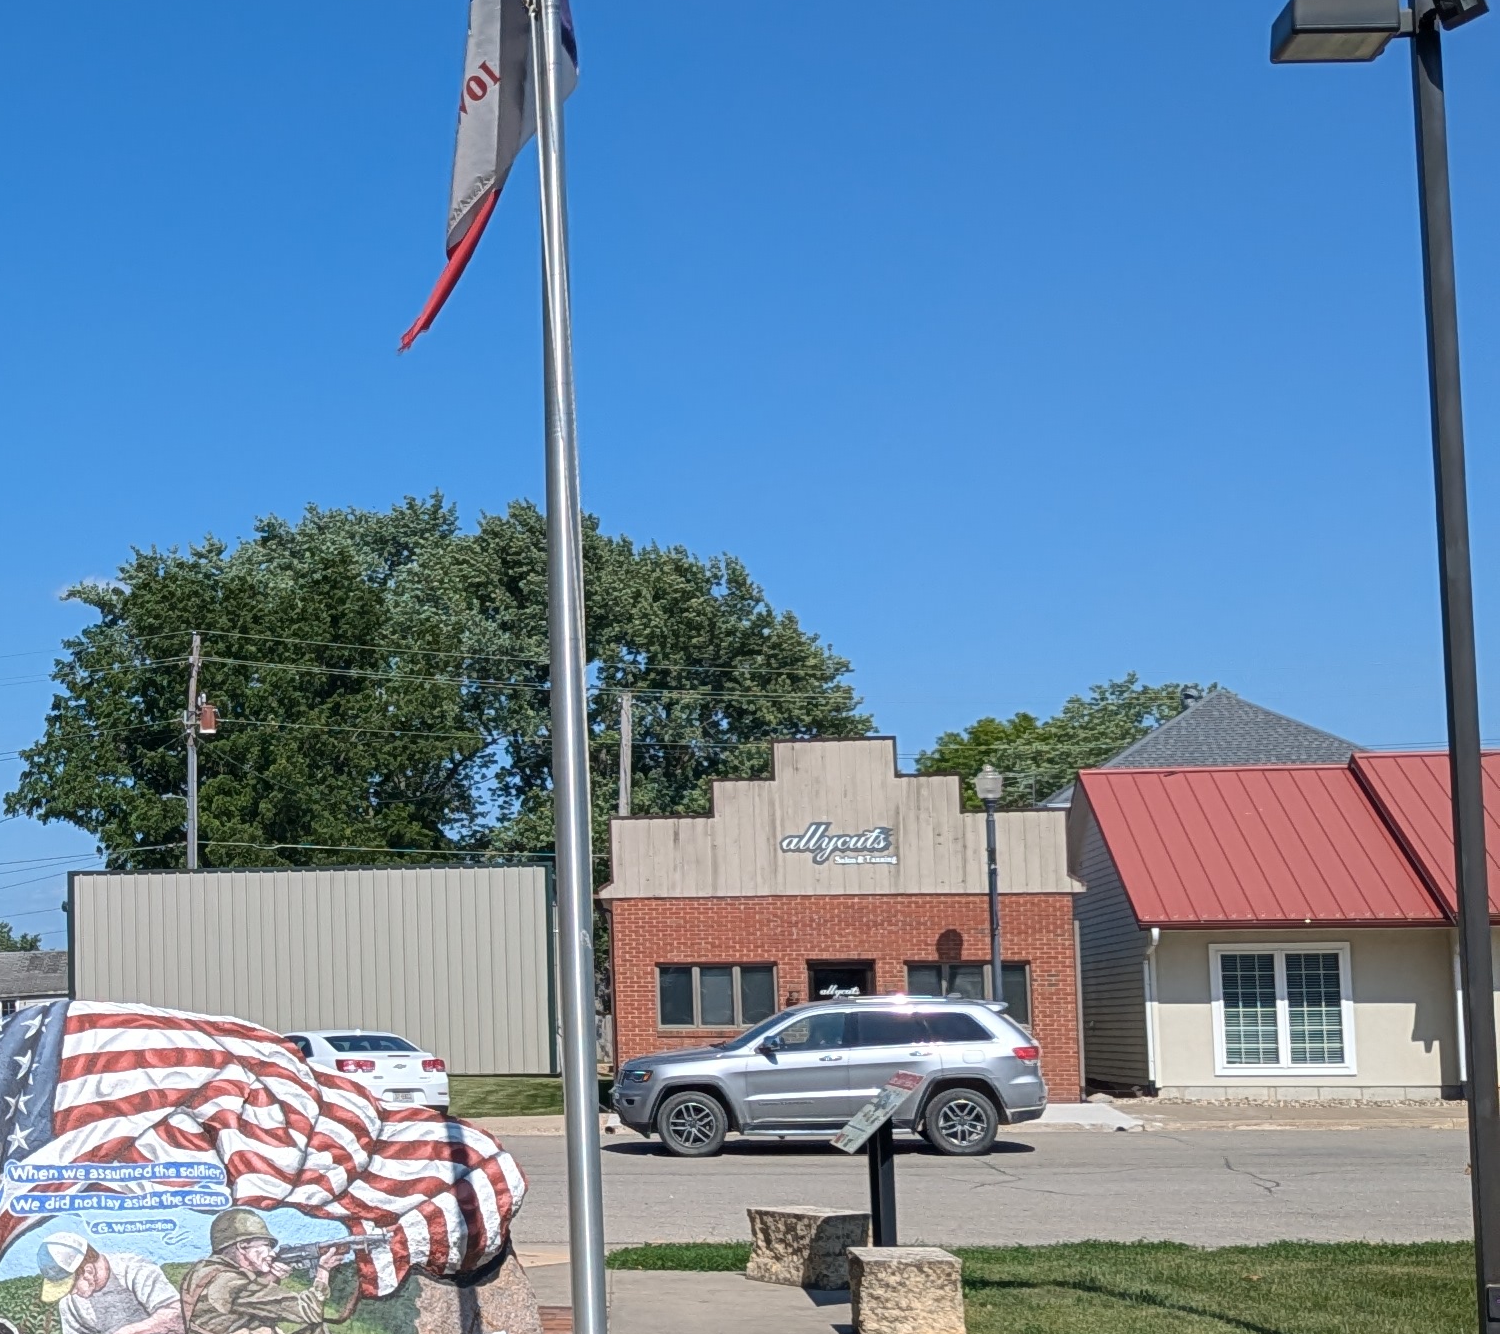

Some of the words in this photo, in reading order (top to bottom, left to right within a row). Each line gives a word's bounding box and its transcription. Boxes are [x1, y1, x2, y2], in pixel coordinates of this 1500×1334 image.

[781, 824, 888, 862] allycuts
[10, 1166, 59, 1181] When
[62, 1168, 86, 1179] we
[89, 1164, 153, 1180] assumed
[154, 1164, 177, 1177] the
[180, 1164, 224, 1180] soldier,
[13, 1198, 41, 1211] We
[45, 1196, 71, 1209] did
[74, 1196, 98, 1208] not
[101, 1196, 121, 1210] lay
[123, 1194, 160, 1208] aside
[161, 1193, 183, 1206] the
[184, 1192, 226, 1206] citizen
